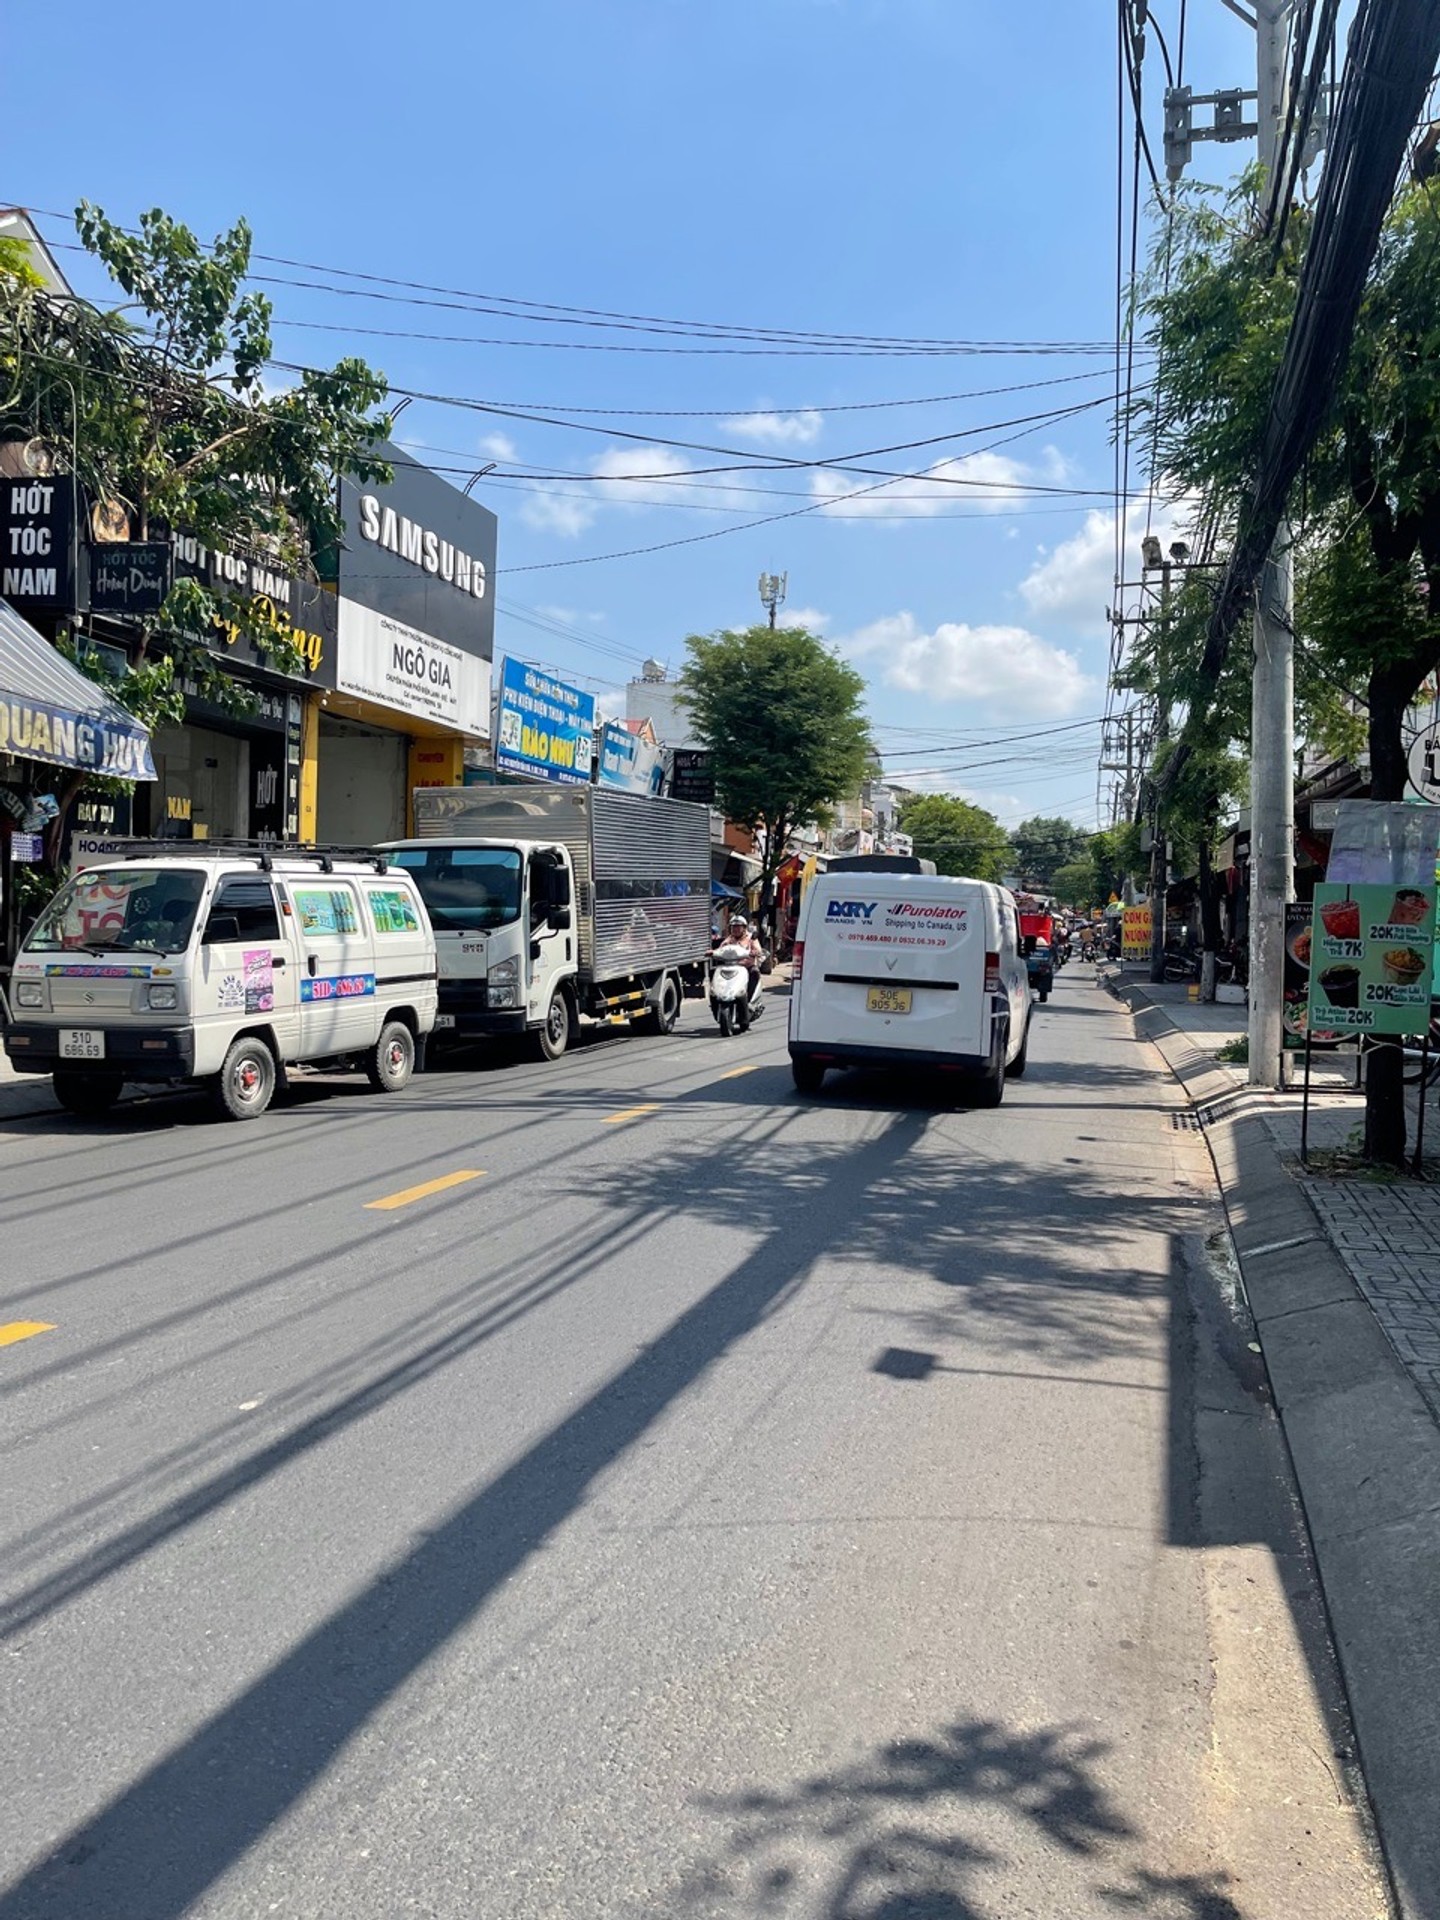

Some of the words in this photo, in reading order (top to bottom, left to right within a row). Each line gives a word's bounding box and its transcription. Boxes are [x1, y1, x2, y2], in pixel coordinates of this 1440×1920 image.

[11, 480, 54, 514] HỚT
[9, 520, 51, 556] TÓC
[361, 494, 486, 598] SAMSUNG
[3, 568, 57, 595] NAM
[251, 566, 291, 603] NAM
[393, 643, 425, 679] NGÔ
[429, 658, 452, 690] GIA
[900, 903, 967, 919] Purolator
[885, 918, 915, 930] Shipping
[917, 920, 925, 929] to
[926, 921, 954, 931] Canada,
[957, 922, 967, 931] US
[1370, 926, 1393, 939] 20K
[1344, 941, 1362, 956] 7K
[880, 989, 898, 1000] 50E
[1366, 984, 1393, 1000] 20K
[1348, 1010, 1373, 1025] 20K
[72, 1032, 91, 1044] 51D
[64, 1045, 100, 1057] 686.69
